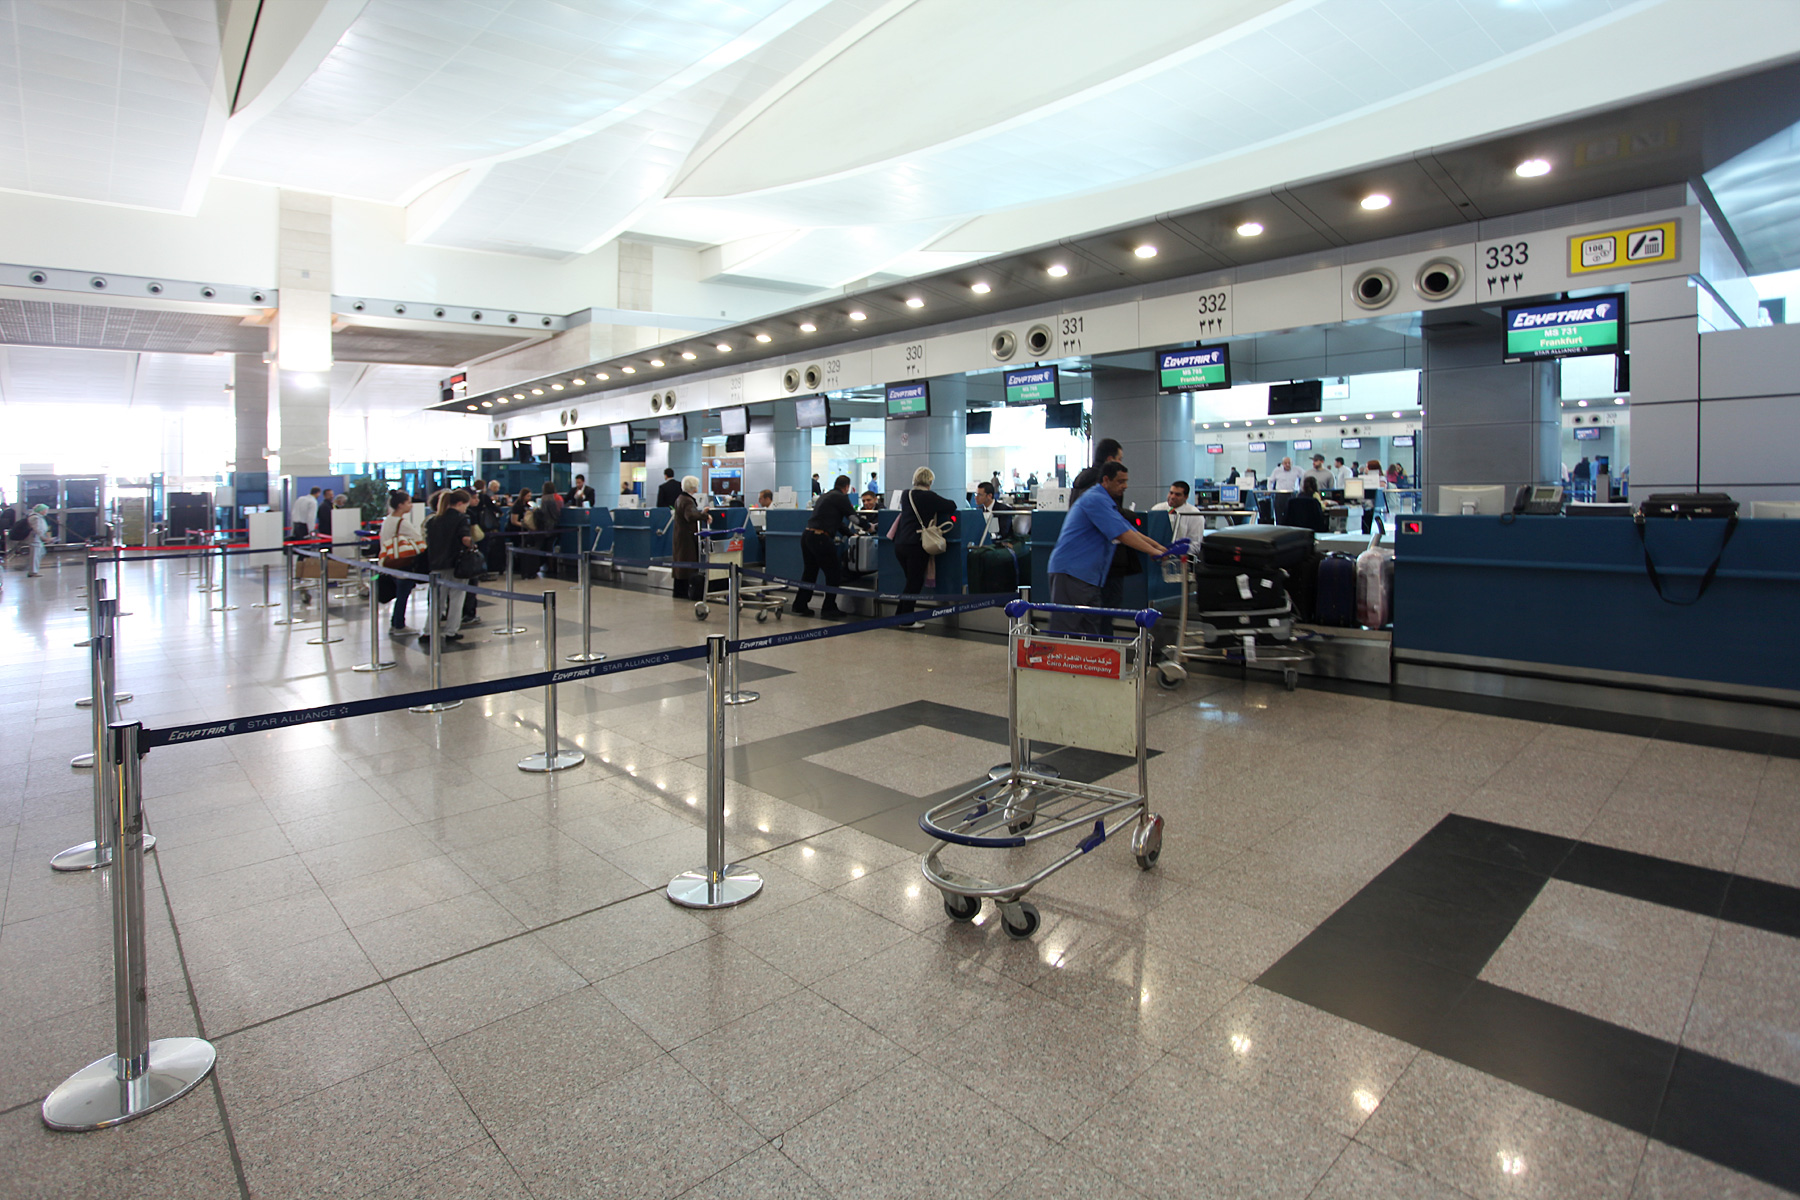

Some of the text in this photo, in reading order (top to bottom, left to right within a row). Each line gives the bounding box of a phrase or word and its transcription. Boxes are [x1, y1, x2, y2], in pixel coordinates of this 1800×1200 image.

[1486, 242, 1528, 270] 333
[1487, 272, 1523, 296] ٣٣٣
[1199, 292, 1226, 314] 332
[1062, 316, 1083, 335] 331
[1200, 317, 1222, 335] ٣٣٢
[1513, 308, 1594, 328] EGYPTAIR
[1544, 327, 1578, 337] MS 731
[1063, 338, 1082, 354] ٣٣١
[1540, 336, 1583, 348] Frankfurt
[906, 344, 922, 360] 330
[827, 360, 840, 374] 329
[1164, 354, 1210, 368] EGYPTAIR
[1008, 374, 1044, 385] EGYPTAIR
[1180, 376, 1206, 384] Frankfurt
[740, 640, 768, 649] EGYPTAIR
[794, 630, 821, 640] ALLIANCE
[552, 657, 660, 681] EGYPTAIR STAR ALLIANCE
[1063, 662, 1083, 670] Airport
[1084, 664, 1112, 673] Company
[168, 708, 336, 741] EGYPTAIR STAR ALLIANCE
